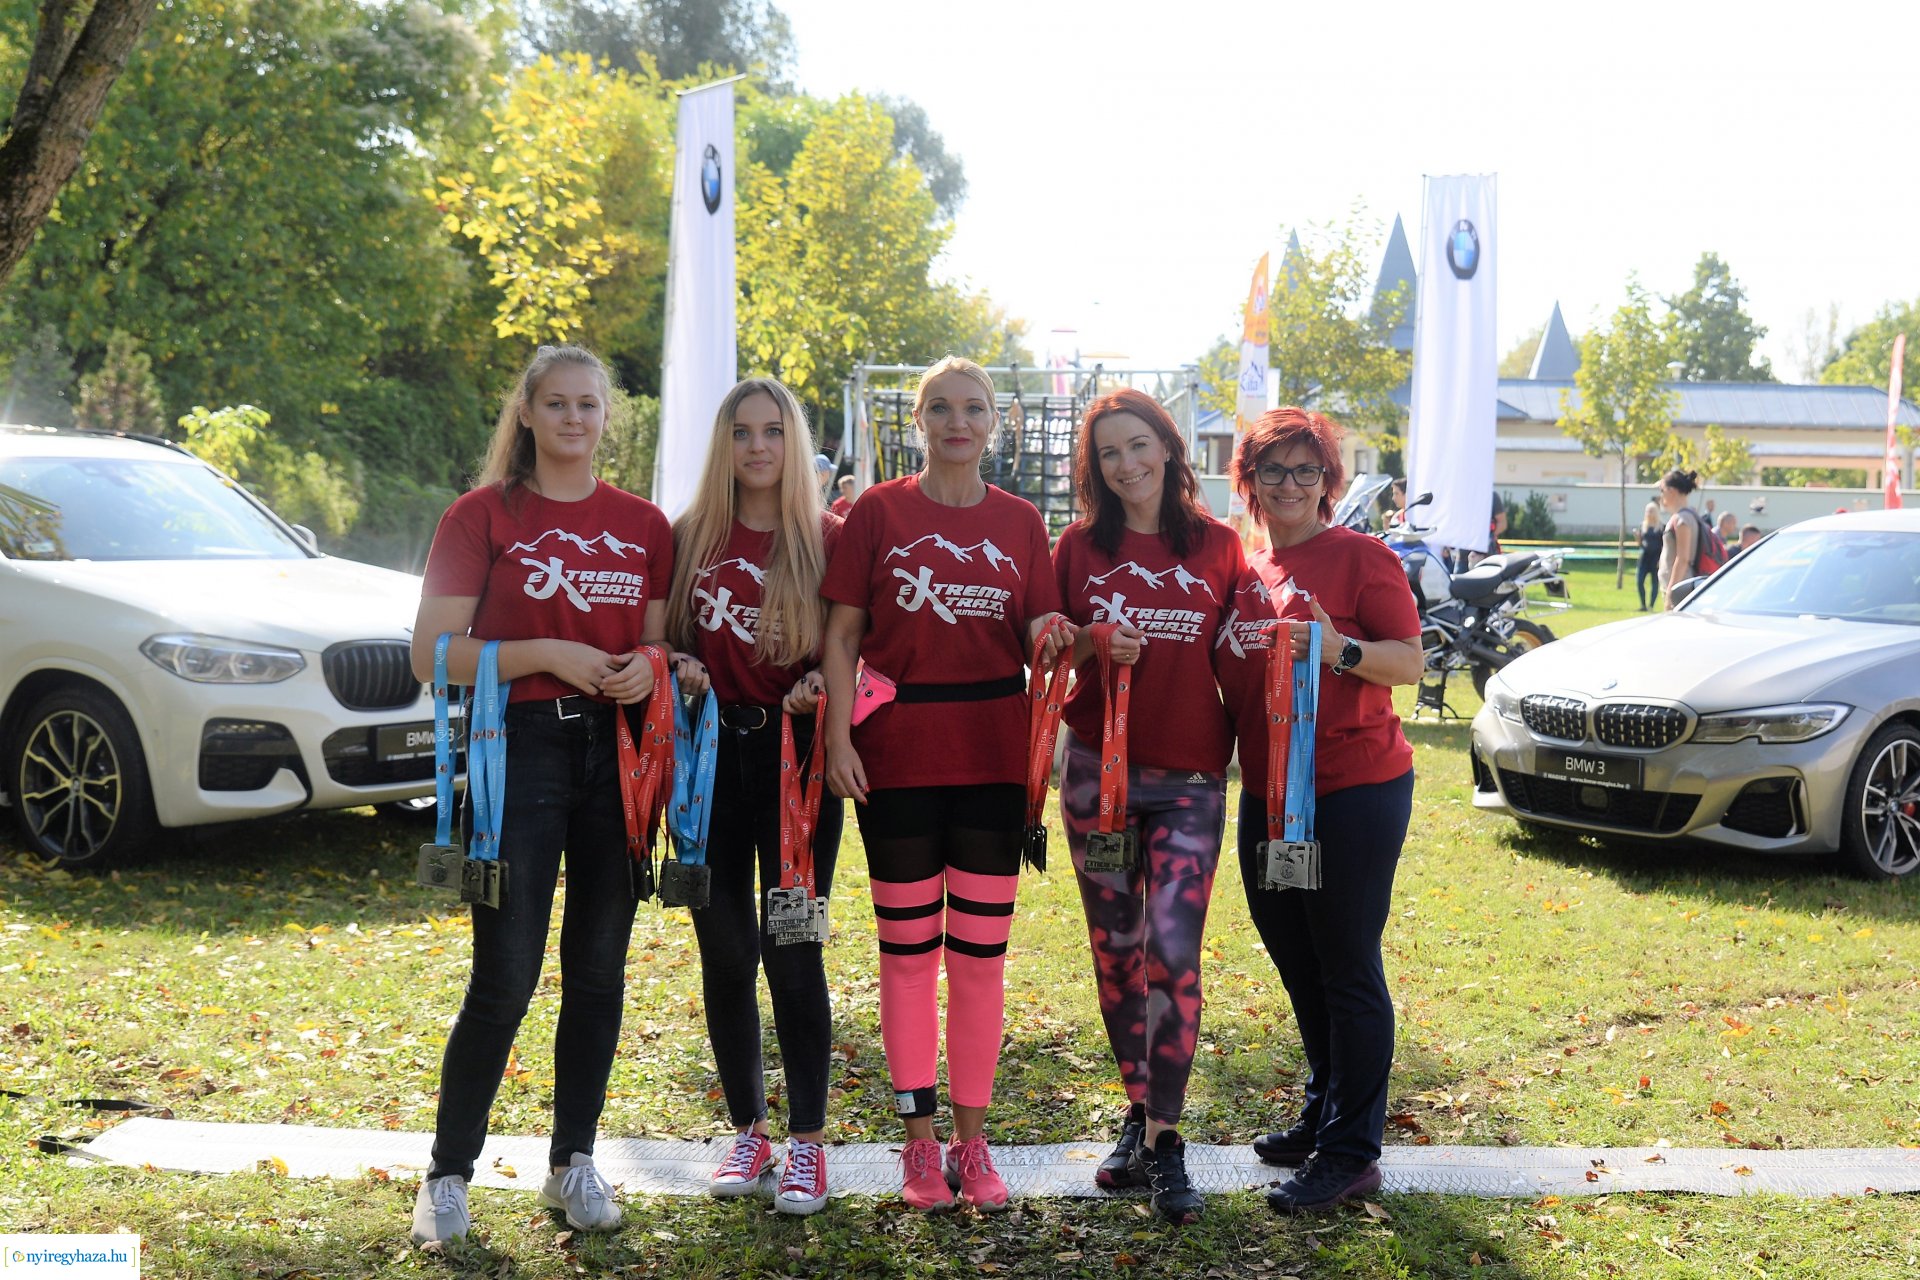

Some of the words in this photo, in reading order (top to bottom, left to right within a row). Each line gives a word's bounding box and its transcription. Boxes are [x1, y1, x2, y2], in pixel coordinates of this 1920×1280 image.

[580, 583, 643, 598] TRAIL
[586, 596, 626, 605] HUNGARY
[627, 598, 638, 606] SE
[953, 608, 992, 618] HUNGARY
[992, 613, 1005, 621] SE
[1137, 620, 1202, 635] TRAIL
[435, 642, 445, 665] Kalifa
[1059, 661, 1068, 683] Kalifa
[437, 720, 447, 743] Kalifa
[1115, 713, 1126, 735] Kalifa
[620, 727, 631, 749] Kalifa
[640, 753, 650, 773] Kalifa
[699, 752, 708, 773] Kalifa
[1565, 756, 1595, 774] BMW
[1597, 761, 1605, 775] 3
[438, 796, 447, 818] Kalifa
[1102, 793, 1112, 815] Kalifa
[806, 868, 814, 890] Kalifa
